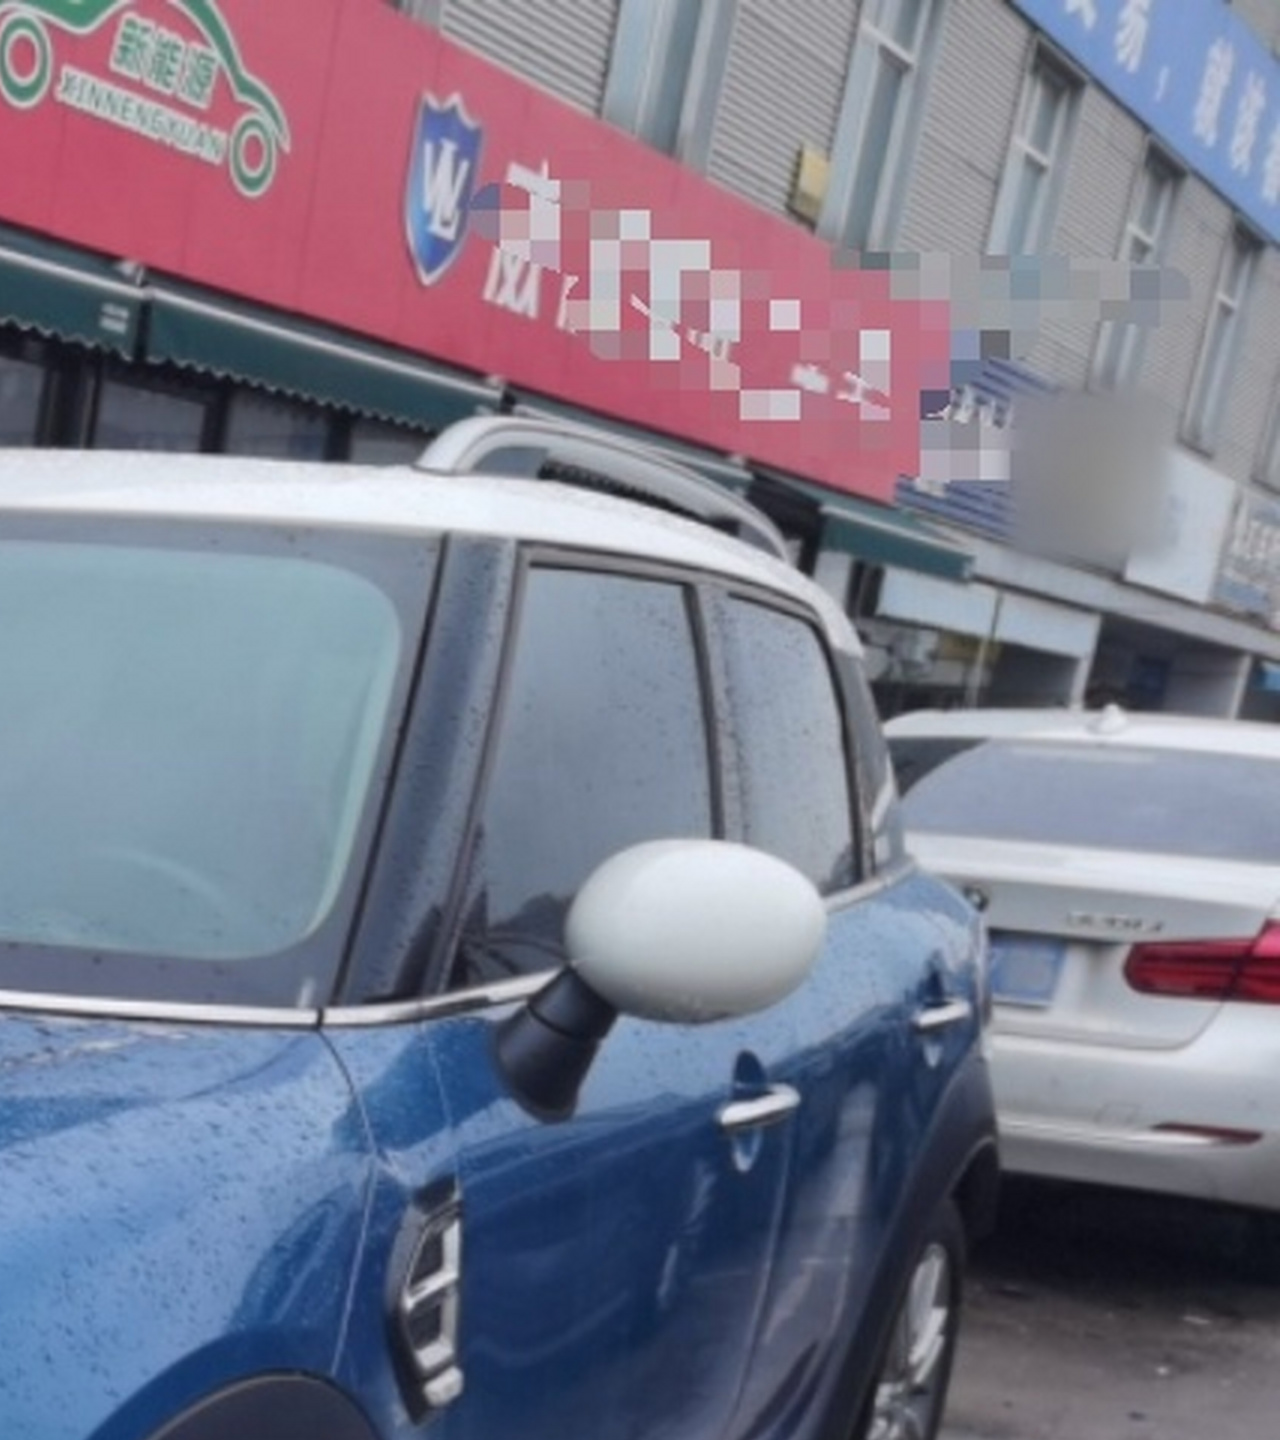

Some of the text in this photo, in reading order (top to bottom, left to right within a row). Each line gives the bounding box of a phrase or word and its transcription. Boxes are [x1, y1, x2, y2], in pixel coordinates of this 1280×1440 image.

[110, 13, 218, 108] 新能源
[57, 66, 226, 163] XINNENGYUAN
